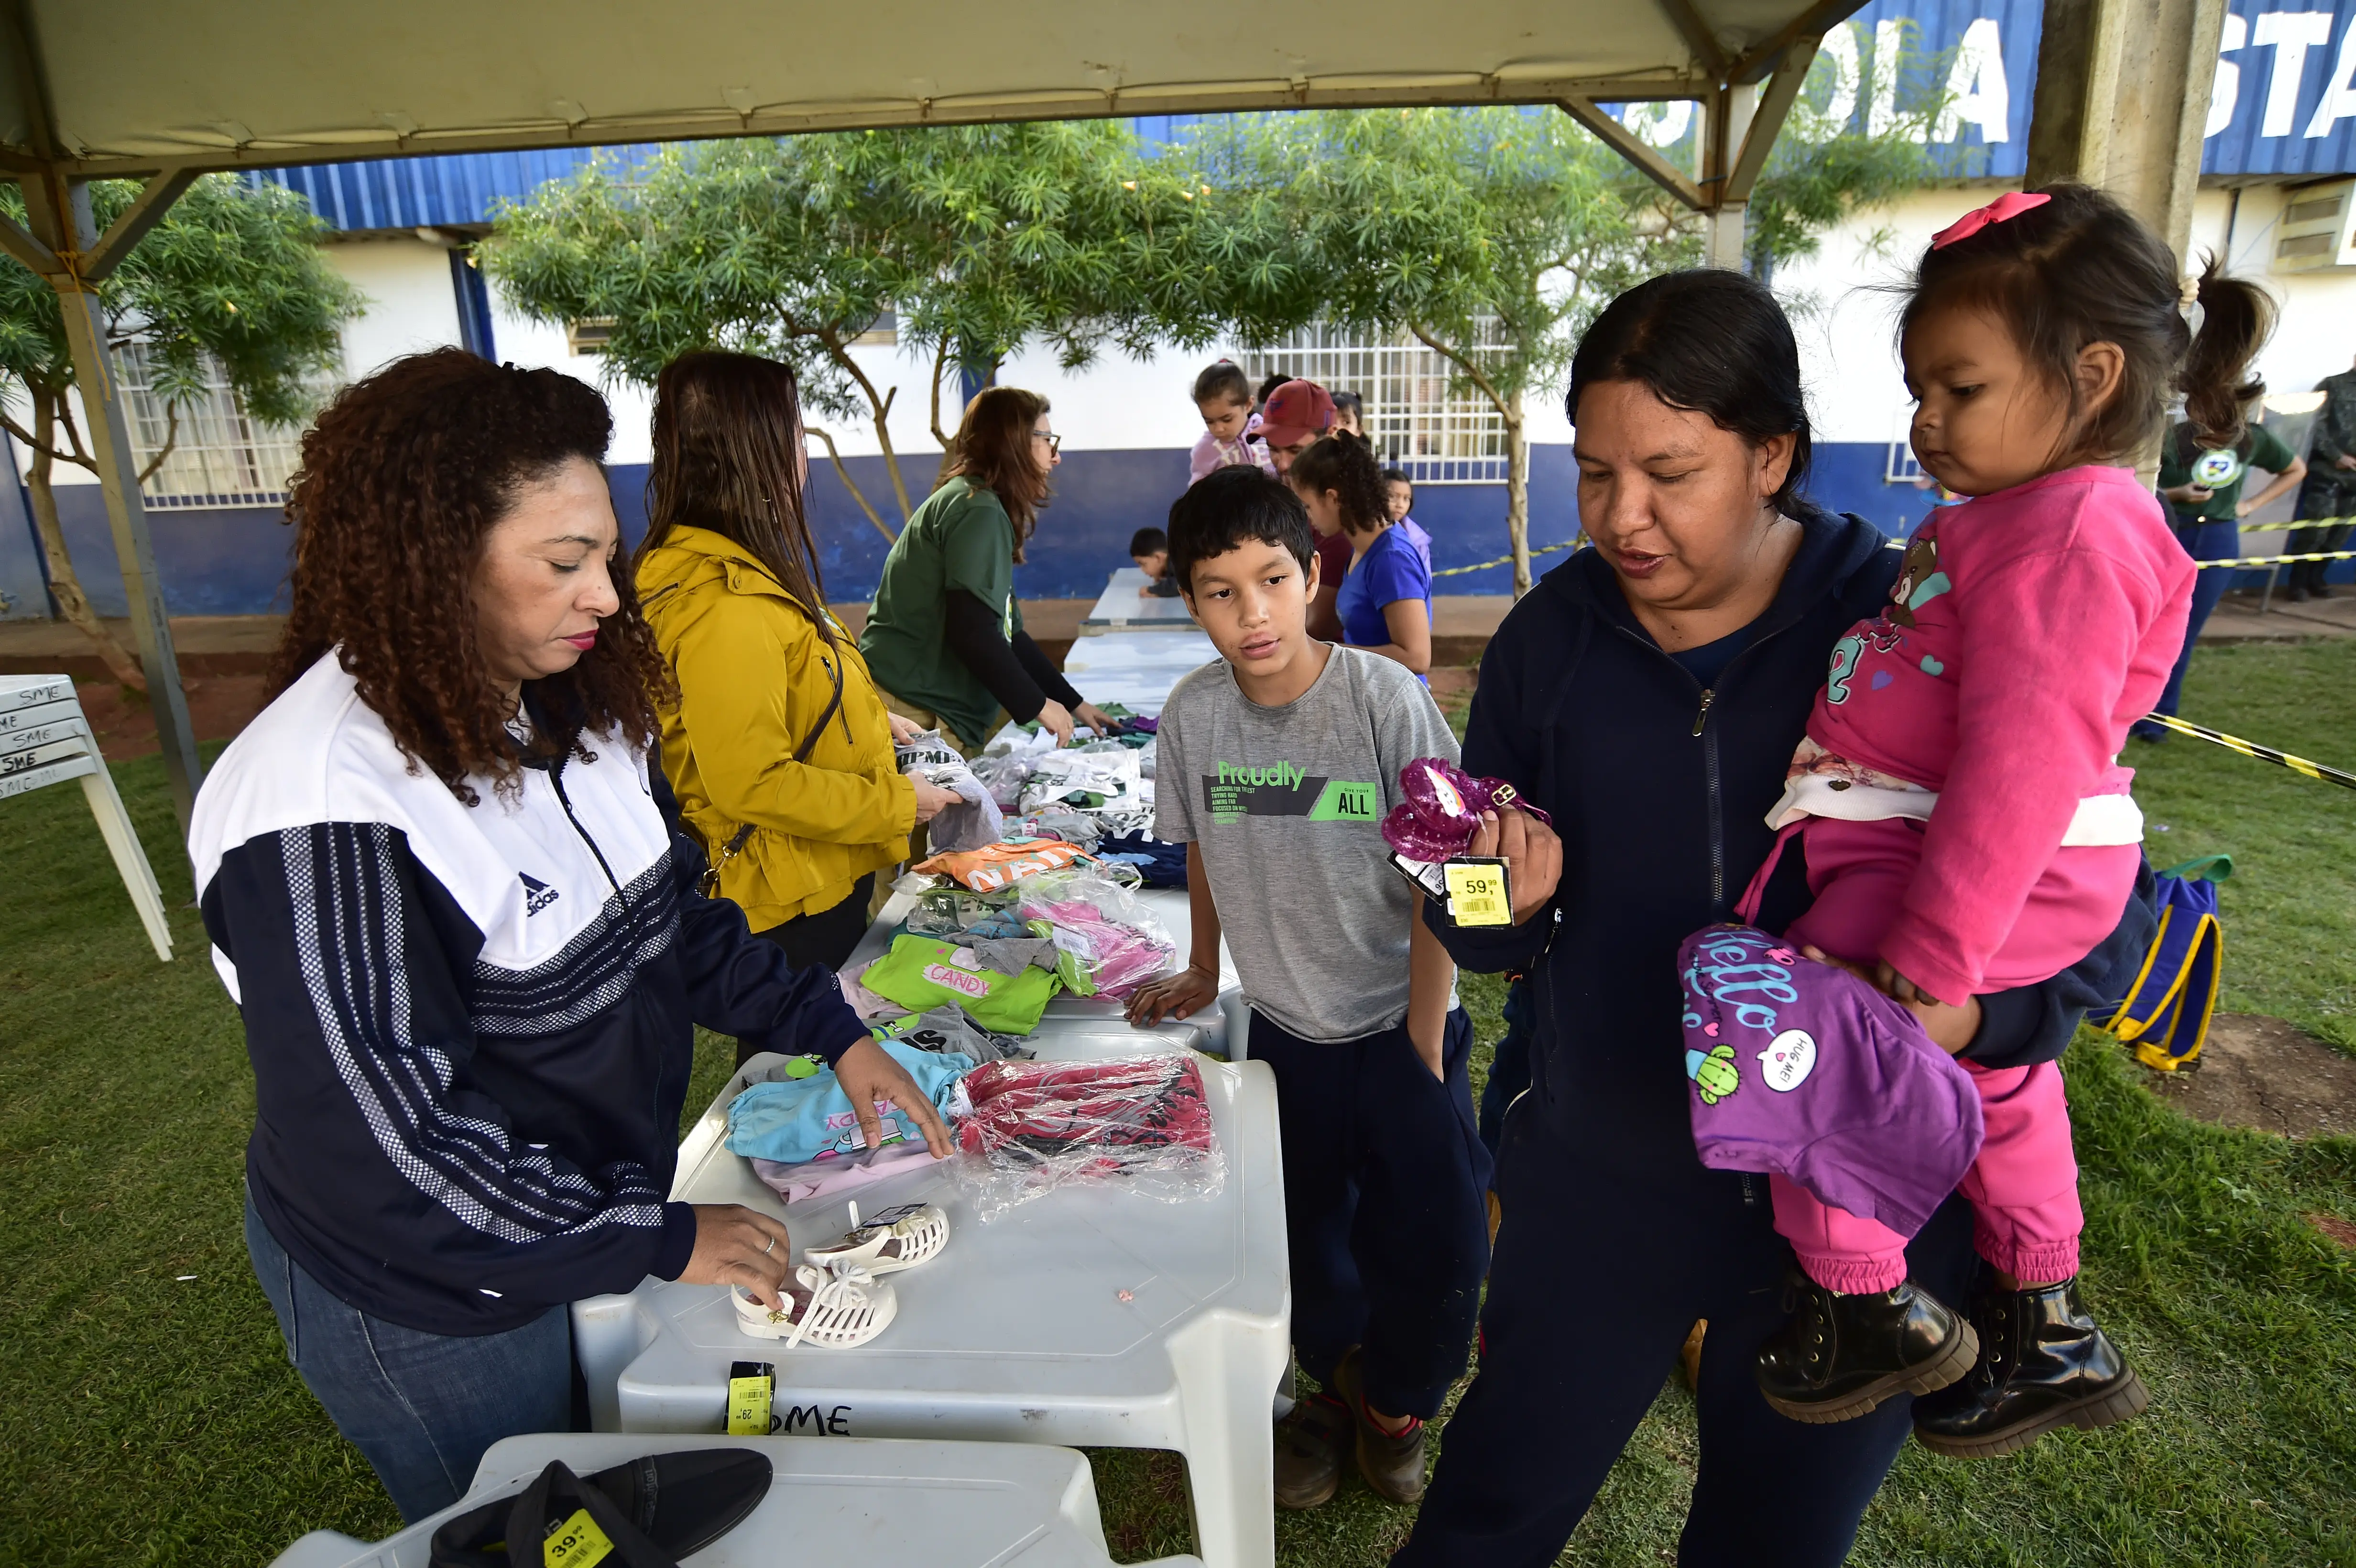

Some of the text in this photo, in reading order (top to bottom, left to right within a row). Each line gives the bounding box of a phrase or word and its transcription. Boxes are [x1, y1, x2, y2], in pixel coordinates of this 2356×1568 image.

[20, 685, 60, 706] SME
[13, 729, 52, 748] SME
[2, 751, 37, 772] SME
[1218, 761, 1306, 792] Proudly
[1338, 793, 1370, 815] ALL
[1466, 879, 1497, 895] 59,99
[527, 889, 559, 917] didas
[929, 965, 992, 996] CANDY
[1699, 930, 1799, 1037] Hello
[1780, 1037, 1808, 1084] HUG ME!
